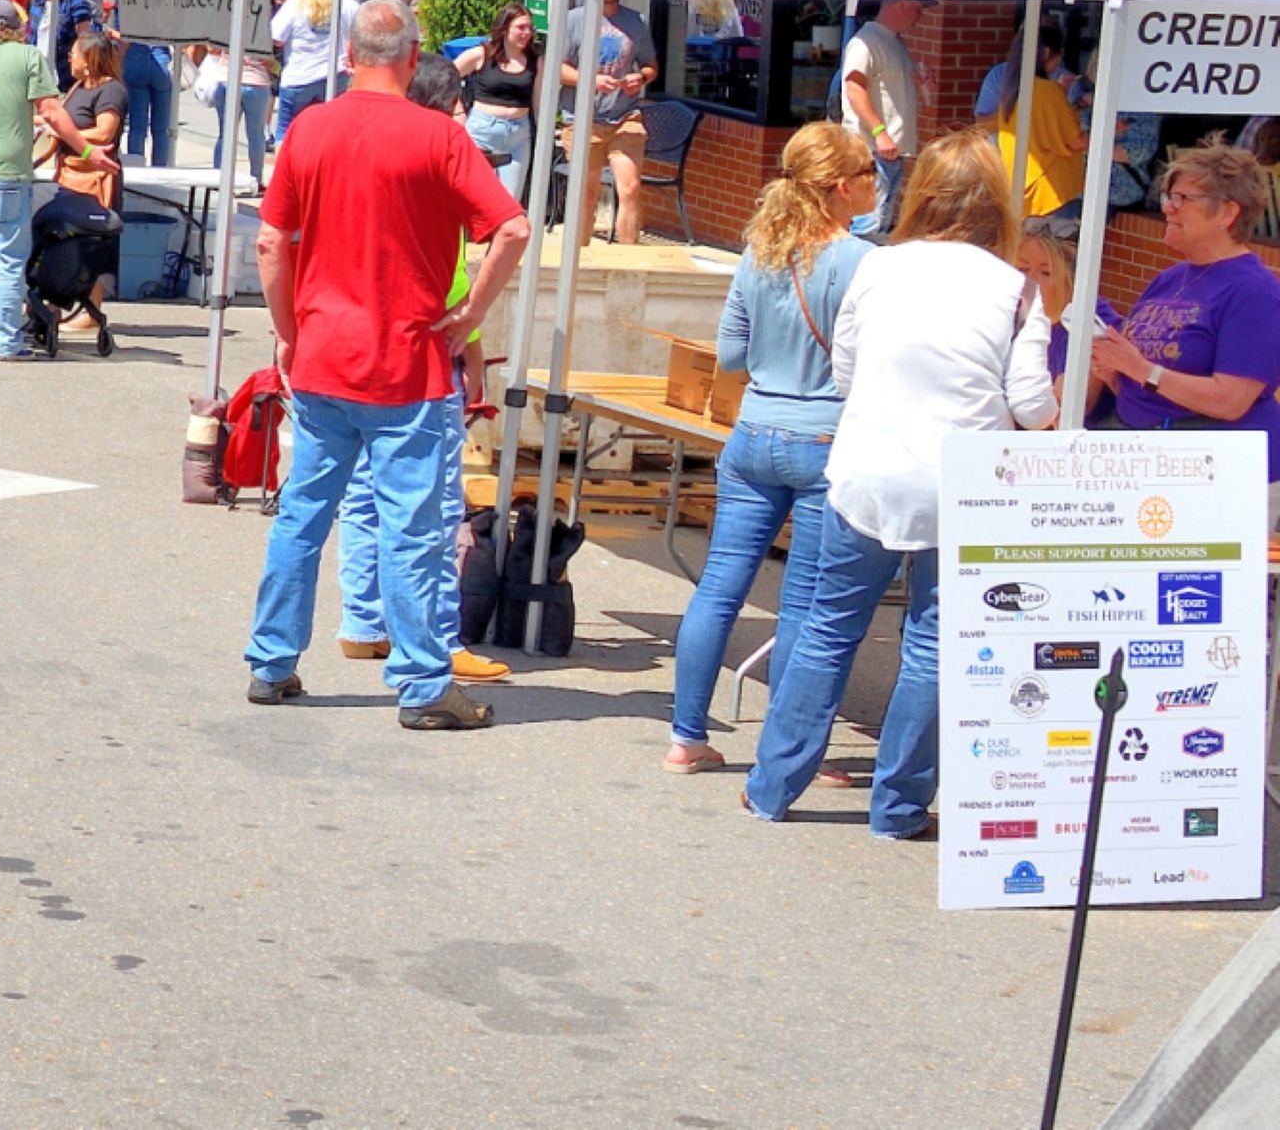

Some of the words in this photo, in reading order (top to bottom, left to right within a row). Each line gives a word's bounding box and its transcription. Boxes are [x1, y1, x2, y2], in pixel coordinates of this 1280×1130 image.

[1138, 11, 1280, 47] CREDIT
[1144, 61, 1261, 95] CARD
[1069, 444, 1146, 454] BUDBREAK
[1013, 455, 1066, 478] WINE
[1072, 457, 1083, 478] &
[1088, 455, 1151, 478] CRAFT
[1156, 455, 1206, 478] BEER
[1075, 480, 1140, 490] FESTIVAL
[959, 499, 1005, 507] PRESENTED
[1009, 499, 1019, 507] BY
[1031, 503, 1078, 513] ROTARY
[1081, 502, 1115, 513] CLUB
[1031, 517, 1046, 527] OF
[1051, 517, 1094, 527] MOUNT
[1097, 516, 1124, 527] AIRY
[994, 547, 1044, 560] PLEASE
[1048, 548, 1107, 560] SUPPORT
[1110, 548, 1138, 559] OUR
[1141, 547, 1207, 559] SPONSORS
[959, 568, 981, 576] GOLD
[986, 590, 1045, 606] CyberGear
[1067, 609, 1098, 621] FISH
[1102, 608, 1146, 621] HIPPIE
[1130, 642, 1181, 655] COOKE
[965, 664, 1005, 675] Allstate
[959, 719, 990, 727] BRONZE
[987, 738, 1010, 748] DUKE
[987, 748, 1021, 758] ENERGY
[1009, 771, 1038, 780] Home
[1173, 768, 1238, 778] WORKFORCE
[959, 801, 992, 809] FRIENDS
